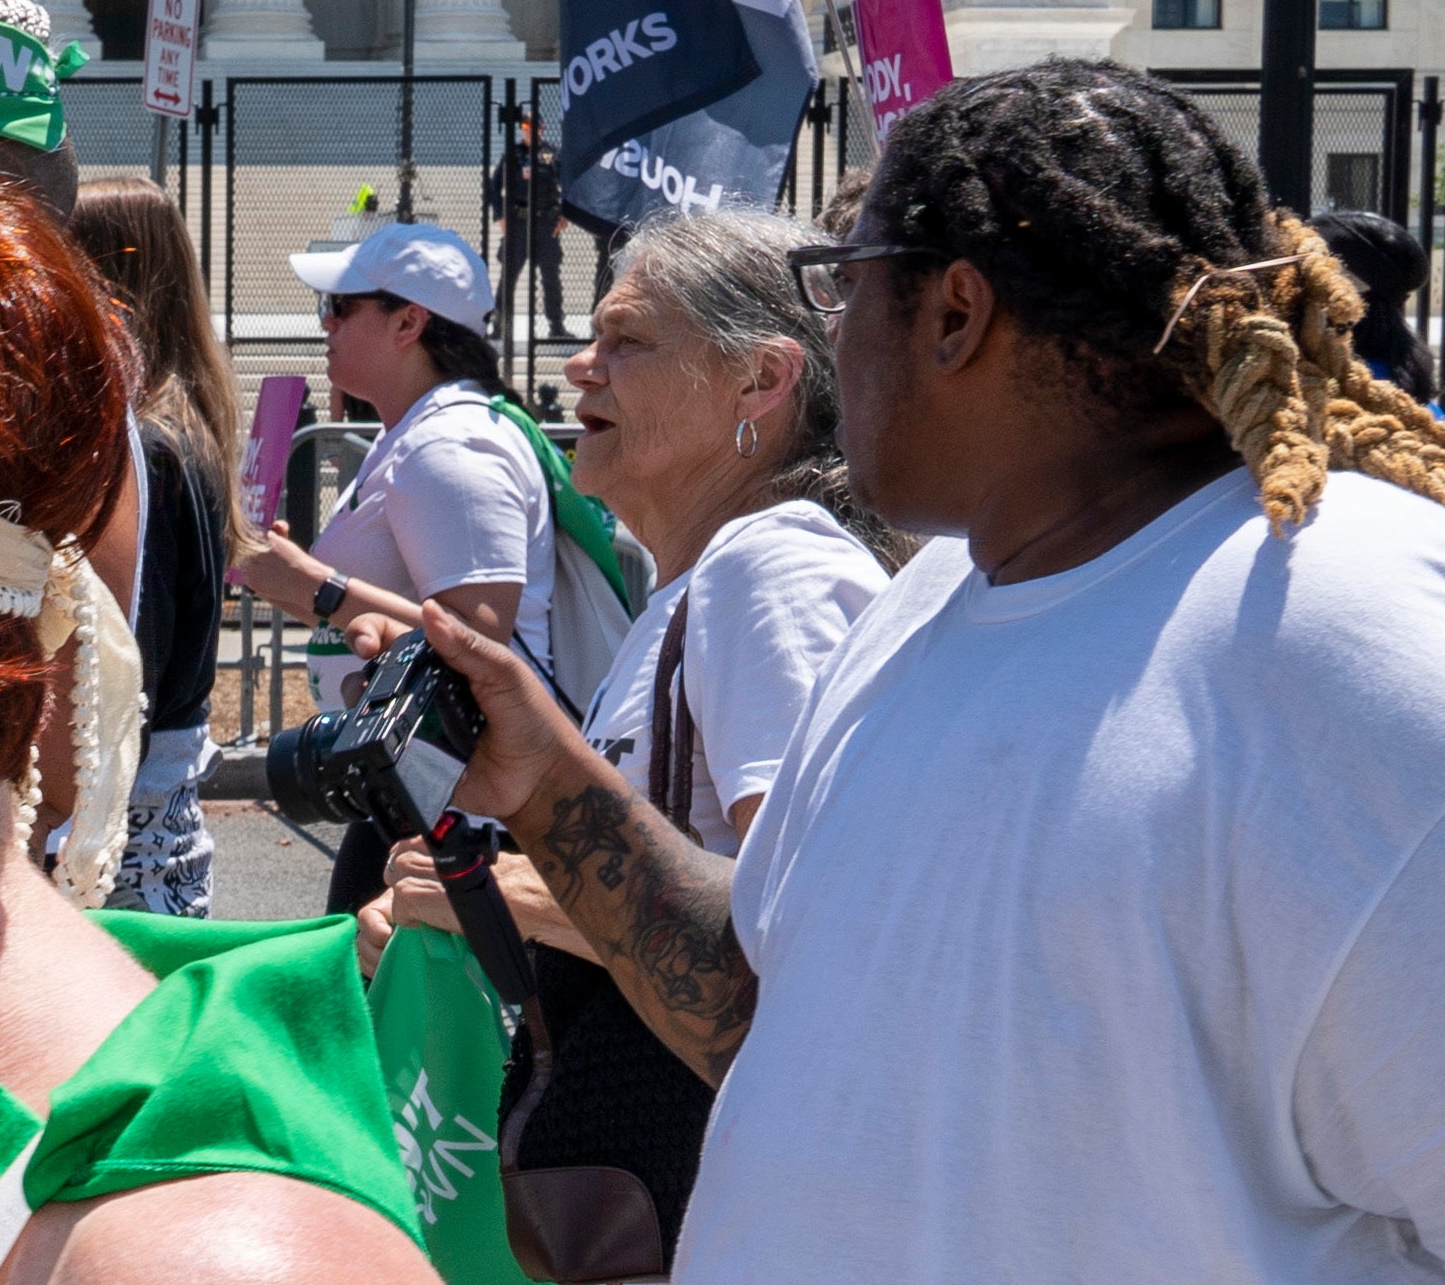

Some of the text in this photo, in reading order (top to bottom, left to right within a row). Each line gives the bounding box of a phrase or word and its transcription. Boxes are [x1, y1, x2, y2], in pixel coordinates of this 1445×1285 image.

[153, 18, 192, 48] PARKING
[160, 48, 180, 65] ANY
[158, 66, 179, 88] TIME
[865, 54, 911, 103] ODY,
